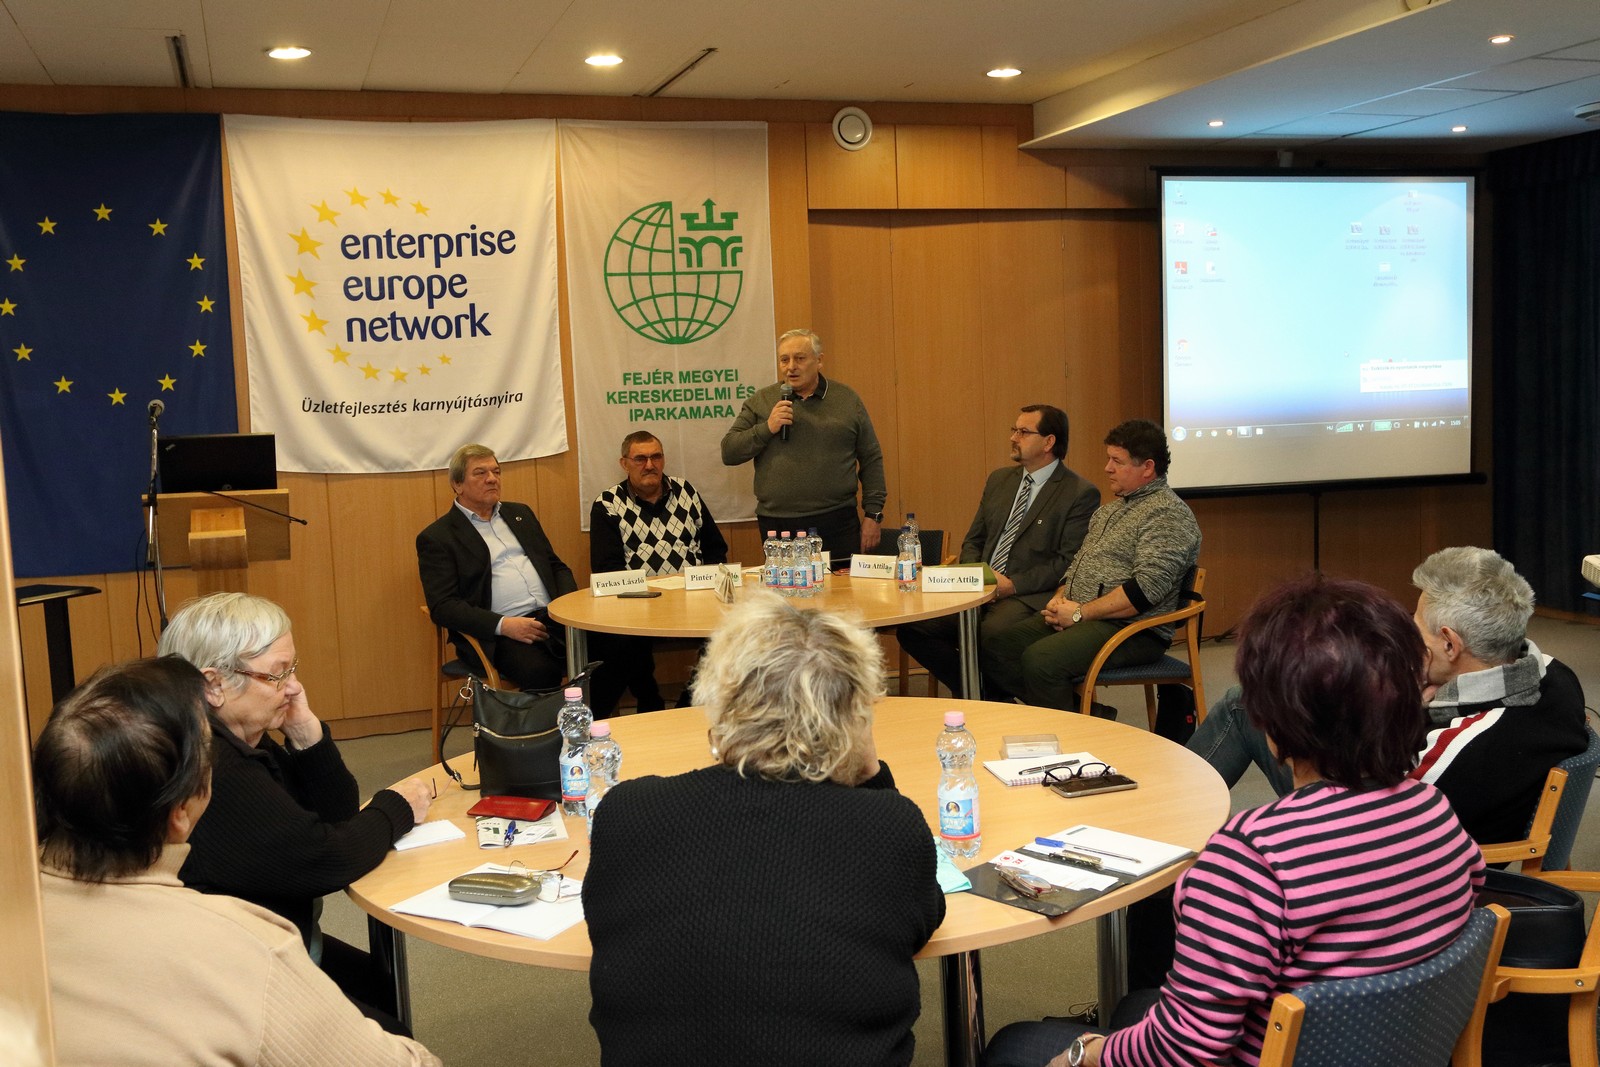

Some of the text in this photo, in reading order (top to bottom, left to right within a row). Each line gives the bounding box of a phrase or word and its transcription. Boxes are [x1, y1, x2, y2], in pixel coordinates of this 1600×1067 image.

[340, 224, 517, 269] enterprise
[343, 270, 468, 310] europe
[346, 303, 493, 343] network
[623, 368, 739, 386] FEJÉR MEGYEI
[606, 384, 756, 405] KERESKEDELMI ÉS
[302, 391, 523, 418] Üzletfejlesztés karnyújtásnyira
[629, 404, 735, 422] IPARKAMARA
[872, 562, 889, 570] Attila
[596, 577, 645, 588] Farkas László
[690, 574, 713, 583] Pintér
[927, 575, 979, 584] Moizer Attila
